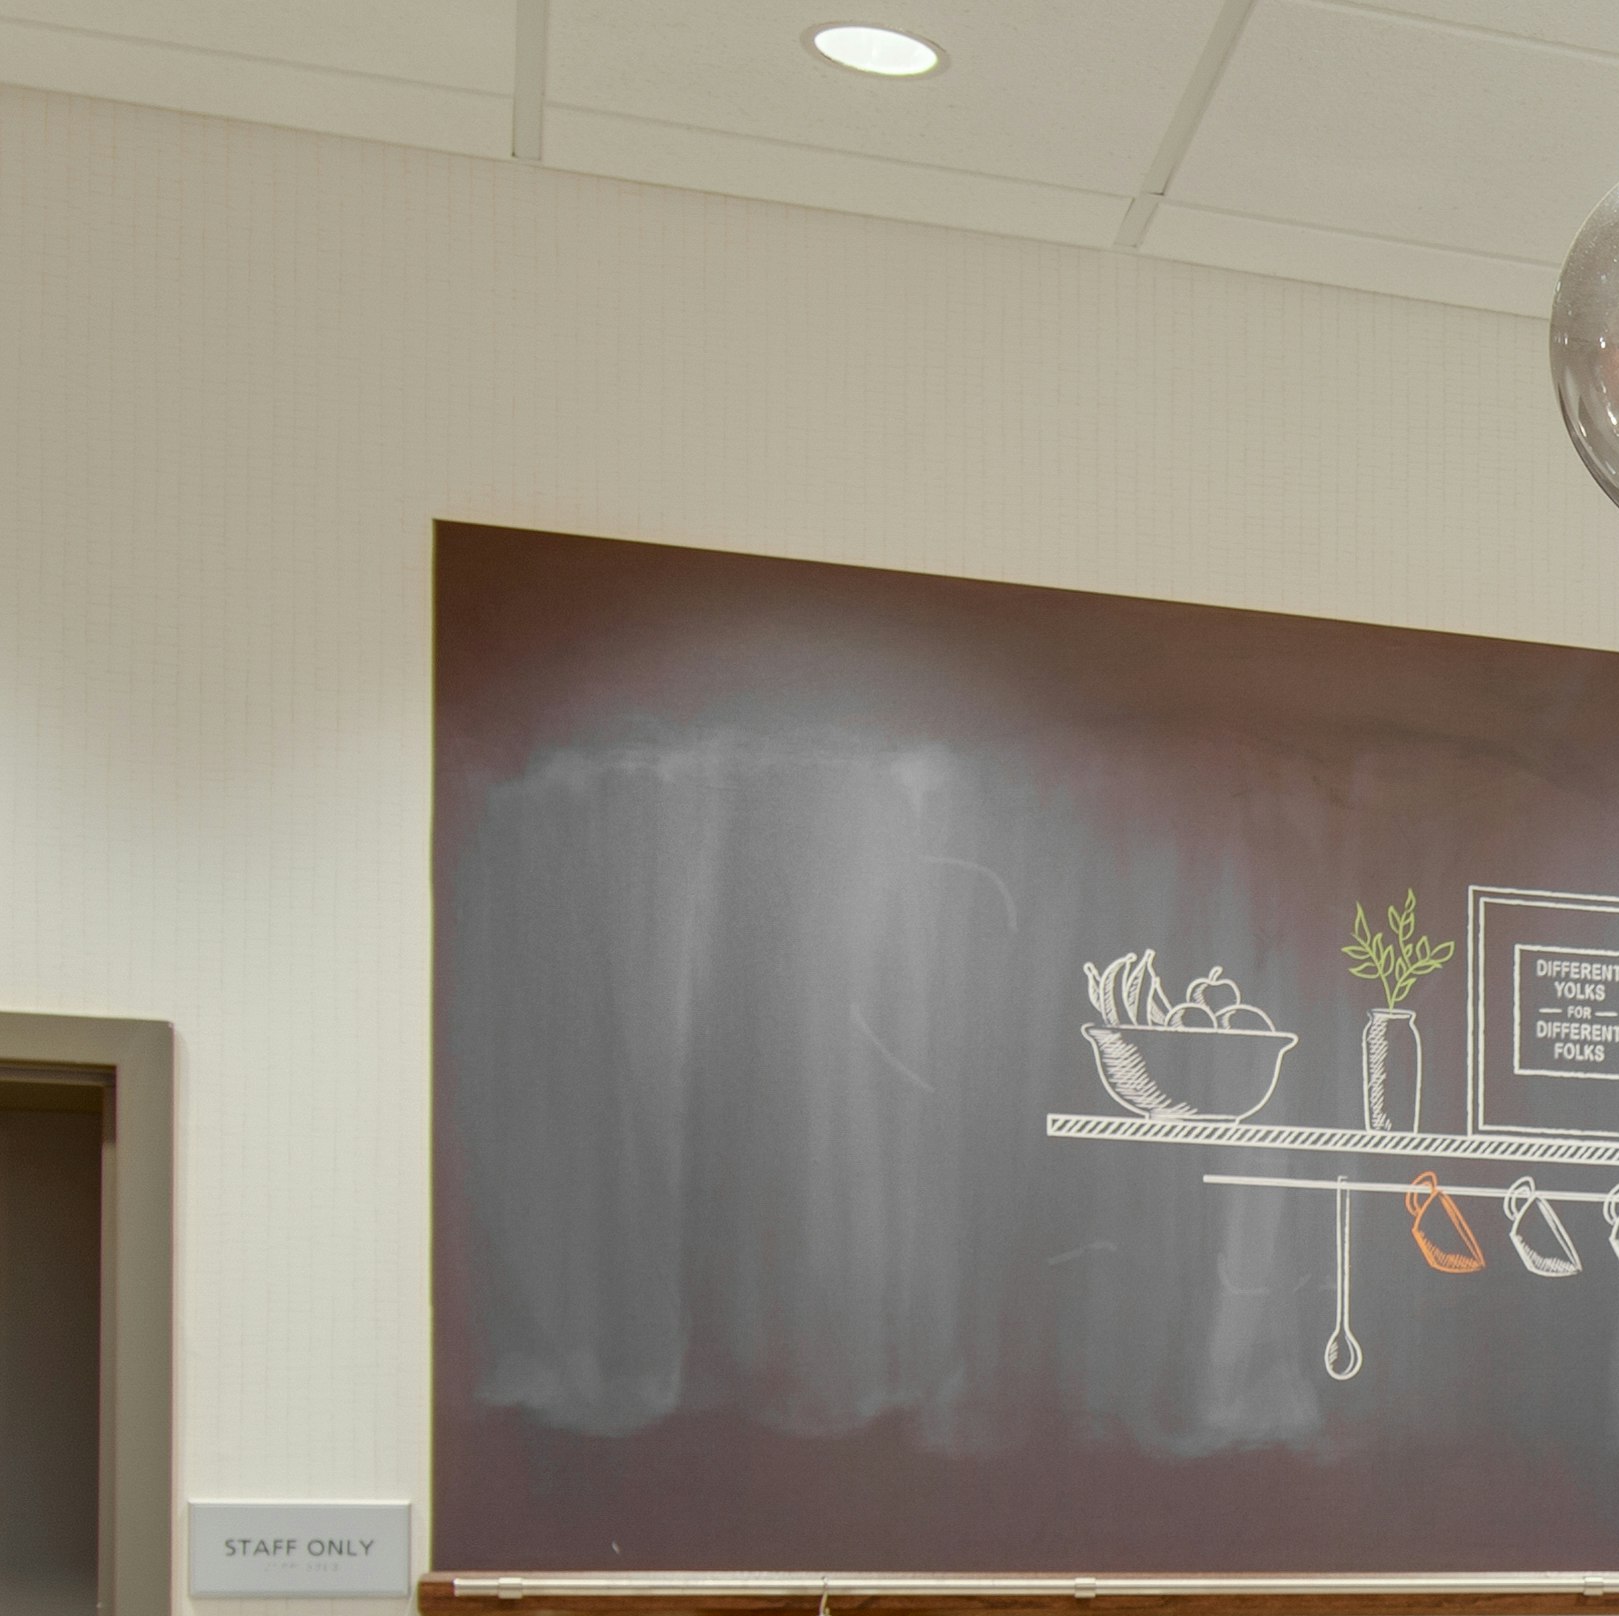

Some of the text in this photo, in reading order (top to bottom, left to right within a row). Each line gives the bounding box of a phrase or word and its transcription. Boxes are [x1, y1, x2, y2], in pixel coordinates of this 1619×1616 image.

[1554, 981, 1606, 1001] YOLKS
[1567, 1006, 1592, 1019] FOR
[1554, 1042, 1605, 1062] FOLKS
[225, 1539, 374, 1557] STAFF ONLY
